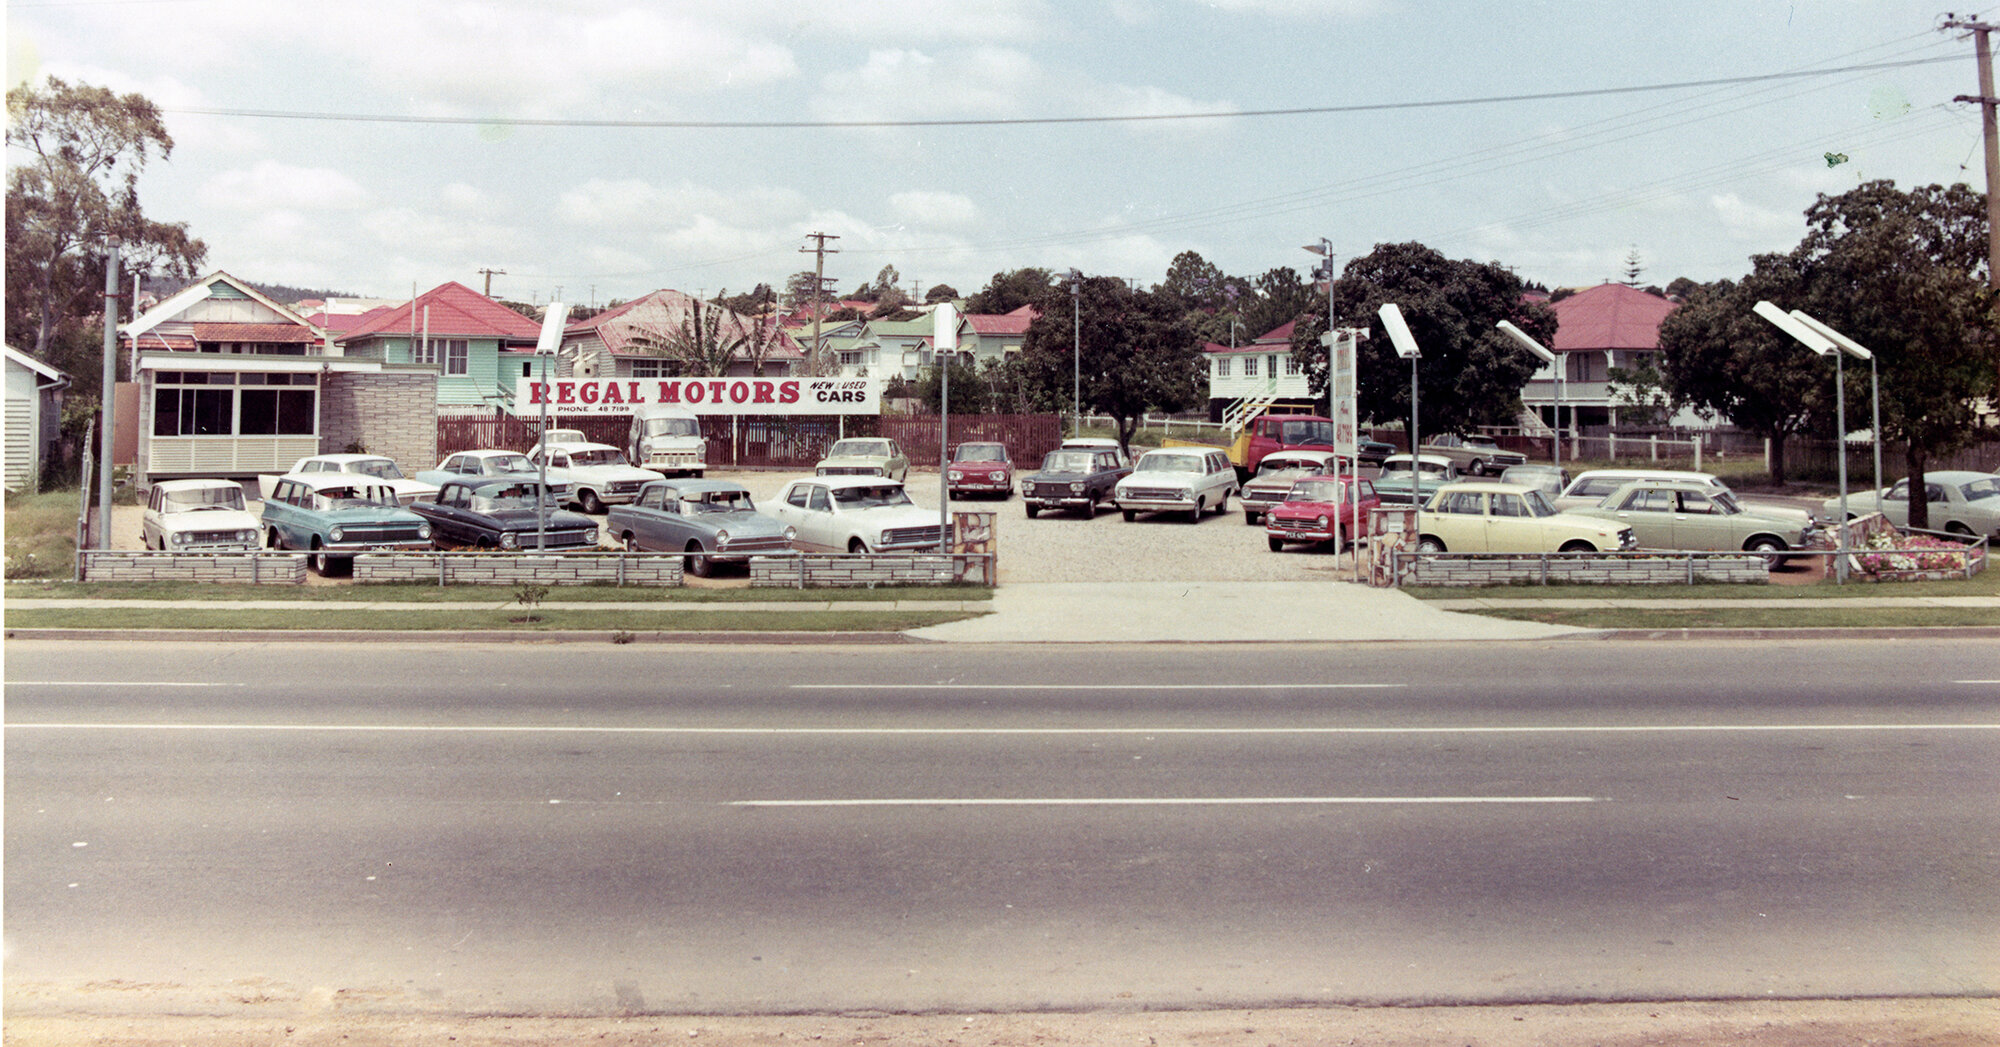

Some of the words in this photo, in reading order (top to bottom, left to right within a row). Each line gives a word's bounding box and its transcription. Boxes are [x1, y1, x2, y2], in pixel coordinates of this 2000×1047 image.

[810, 381, 834, 390] NEW
[841, 381, 867, 390] USED
[529, 381, 645, 404] REGAL
[658, 381, 800, 404] MOTORS
[816, 390, 866, 402] CARS
